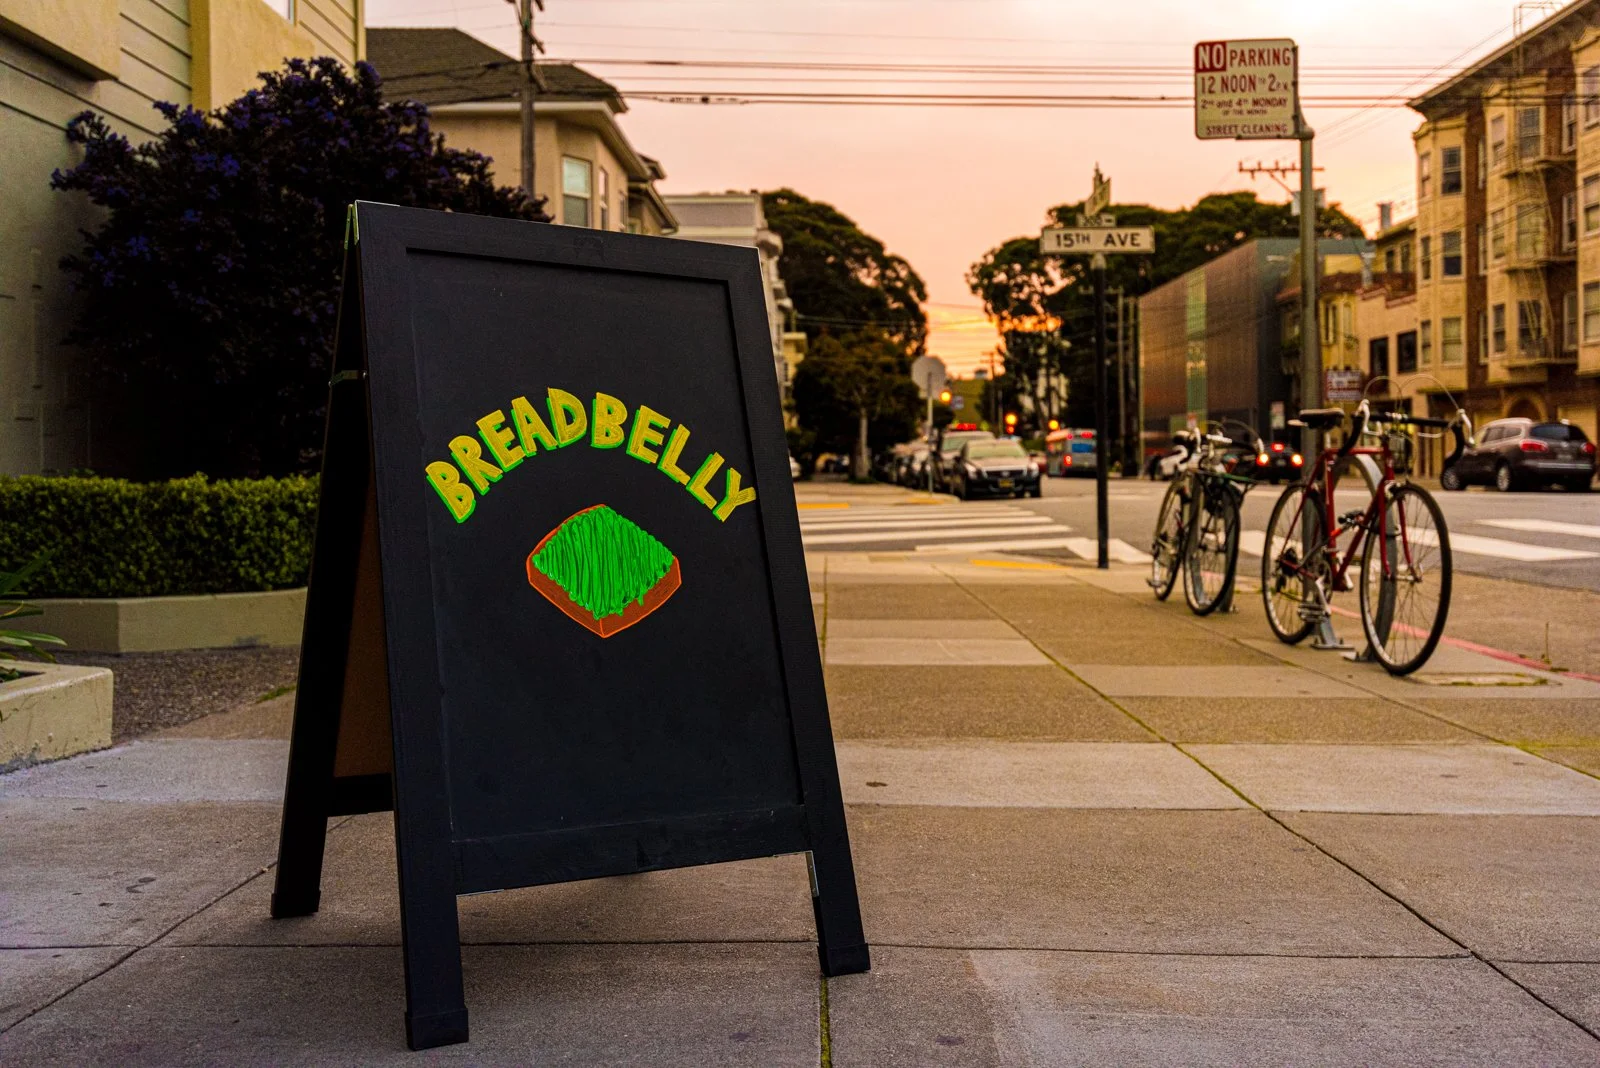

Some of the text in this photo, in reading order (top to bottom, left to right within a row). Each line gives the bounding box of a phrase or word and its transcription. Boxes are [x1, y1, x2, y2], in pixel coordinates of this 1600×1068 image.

[1198, 44, 1291, 70] NO PARKING
[1201, 75, 1216, 94] 12
[1221, 74, 1256, 93] NOON
[1252, 97, 1287, 107] MONDAY
[1207, 122, 1288, 136] STREET CLEANING
[1056, 232, 1141, 247] 15TH AVE
[425, 387, 757, 524] BREADBELLY
